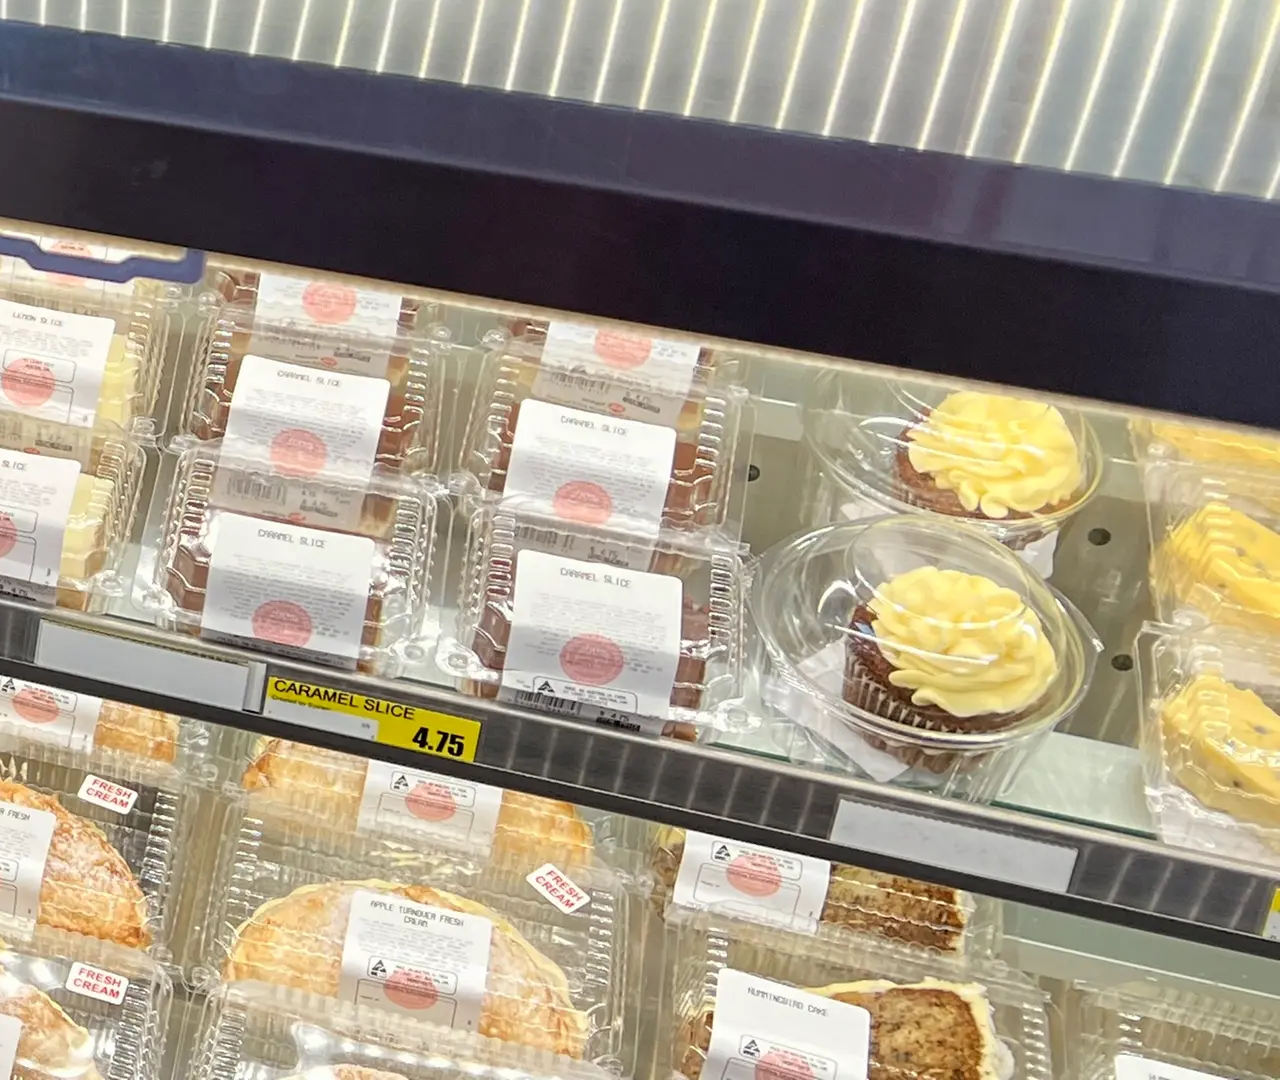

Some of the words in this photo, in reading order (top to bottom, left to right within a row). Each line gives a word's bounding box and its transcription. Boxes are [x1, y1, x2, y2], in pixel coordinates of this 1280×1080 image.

[560, 415, 597, 431] CARAMEL
[600, 425, 629, 437] SLICE
[2, 460, 28, 471] SLICE
[257, 529, 295, 545] CARAMEL
[298, 537, 327, 550] SLICE
[560, 566, 599, 583] CARAMEL
[603, 576, 632, 589] SLICE
[274, 680, 358, 708] CARAMEL
[364, 699, 415, 720] SLICE
[412, 726, 465, 757] 4.75
[86, 787, 129, 809] CREAM
[92, 778, 133, 799] FRESH
[7, 809, 31, 821] FRESH
[535, 875, 575, 909] CREAM
[546, 869, 583, 902] FRESH
[73, 977, 121, 999] CREAM
[78, 967, 122, 989] FRESH
